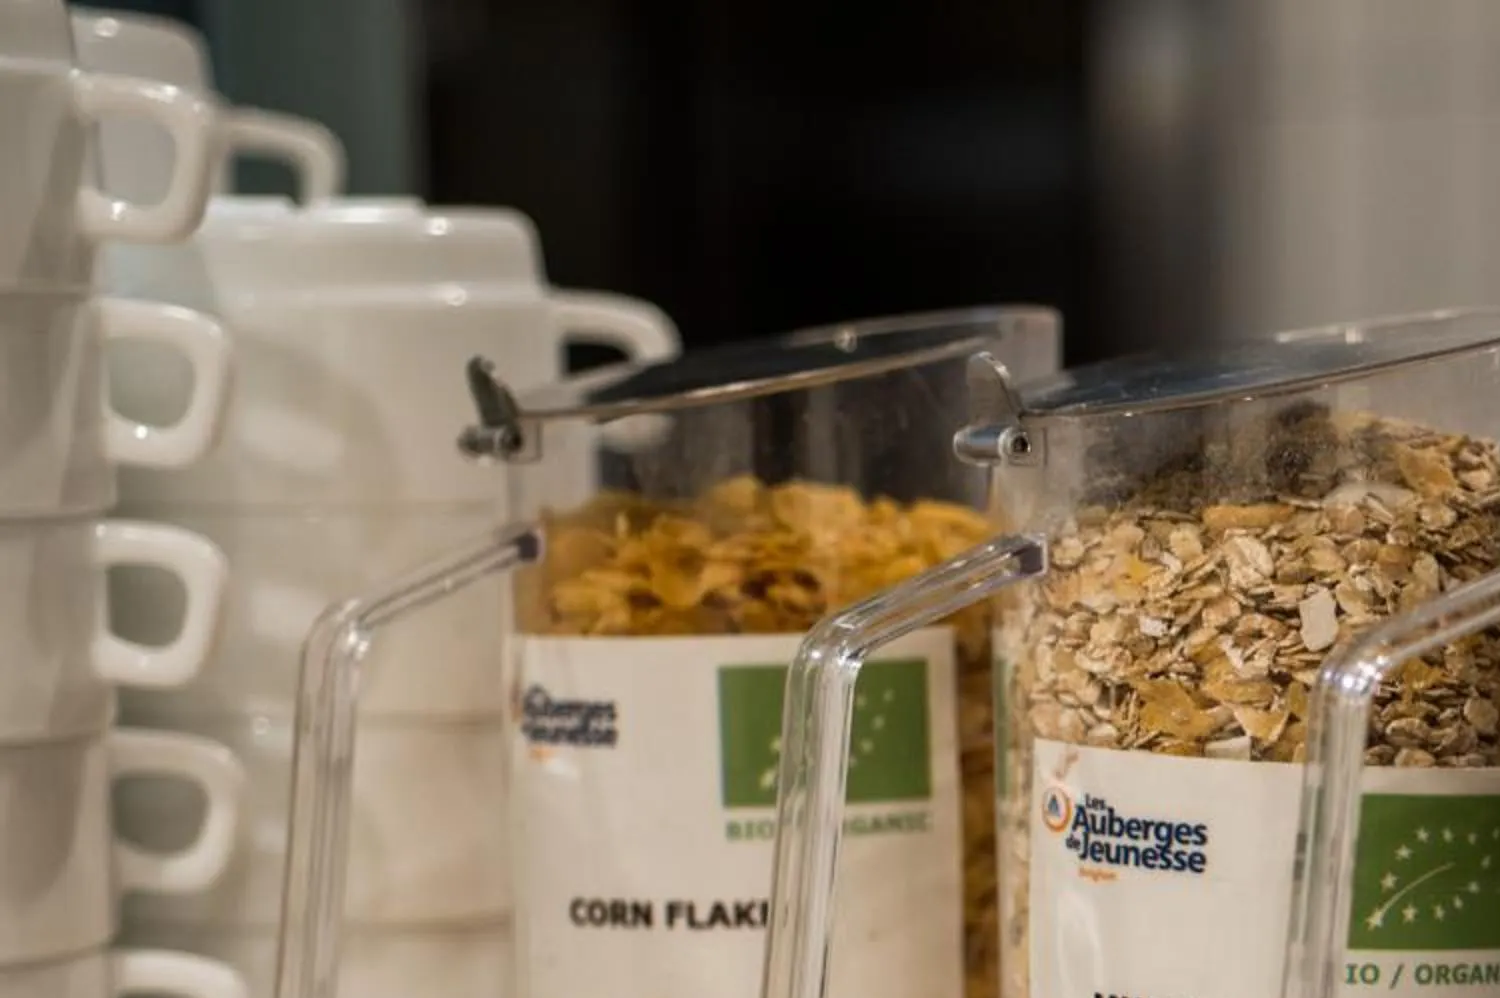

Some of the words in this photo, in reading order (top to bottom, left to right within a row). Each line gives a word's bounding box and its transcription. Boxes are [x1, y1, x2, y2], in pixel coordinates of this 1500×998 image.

[1085, 793, 1107, 811] Les
[842, 810, 932, 836] GANIC
[1072, 804, 1208, 850] Auberges
[1079, 832, 1207, 874] Jeunesse
[569, 896, 654, 929] CORN
[665, 898, 769, 930] FLAK
[1344, 963, 1381, 986] IO
